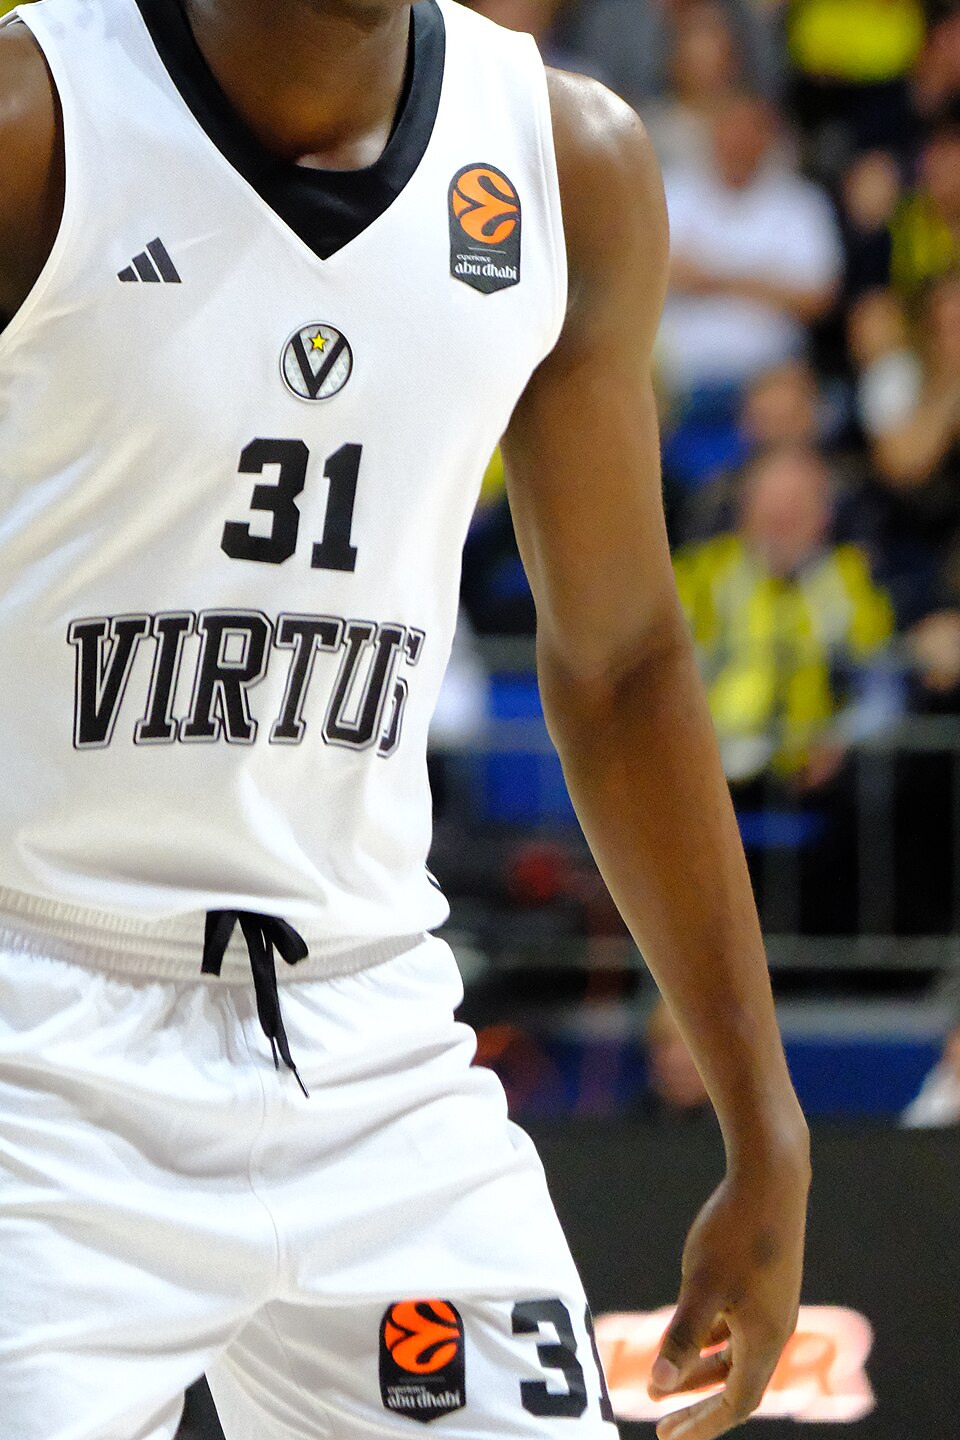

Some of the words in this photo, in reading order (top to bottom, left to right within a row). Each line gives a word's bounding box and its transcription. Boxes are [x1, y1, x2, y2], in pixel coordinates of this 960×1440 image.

[455, 261, 481, 276] abu
[482, 263, 517, 280] dhabi
[220, 437, 363, 572] 31
